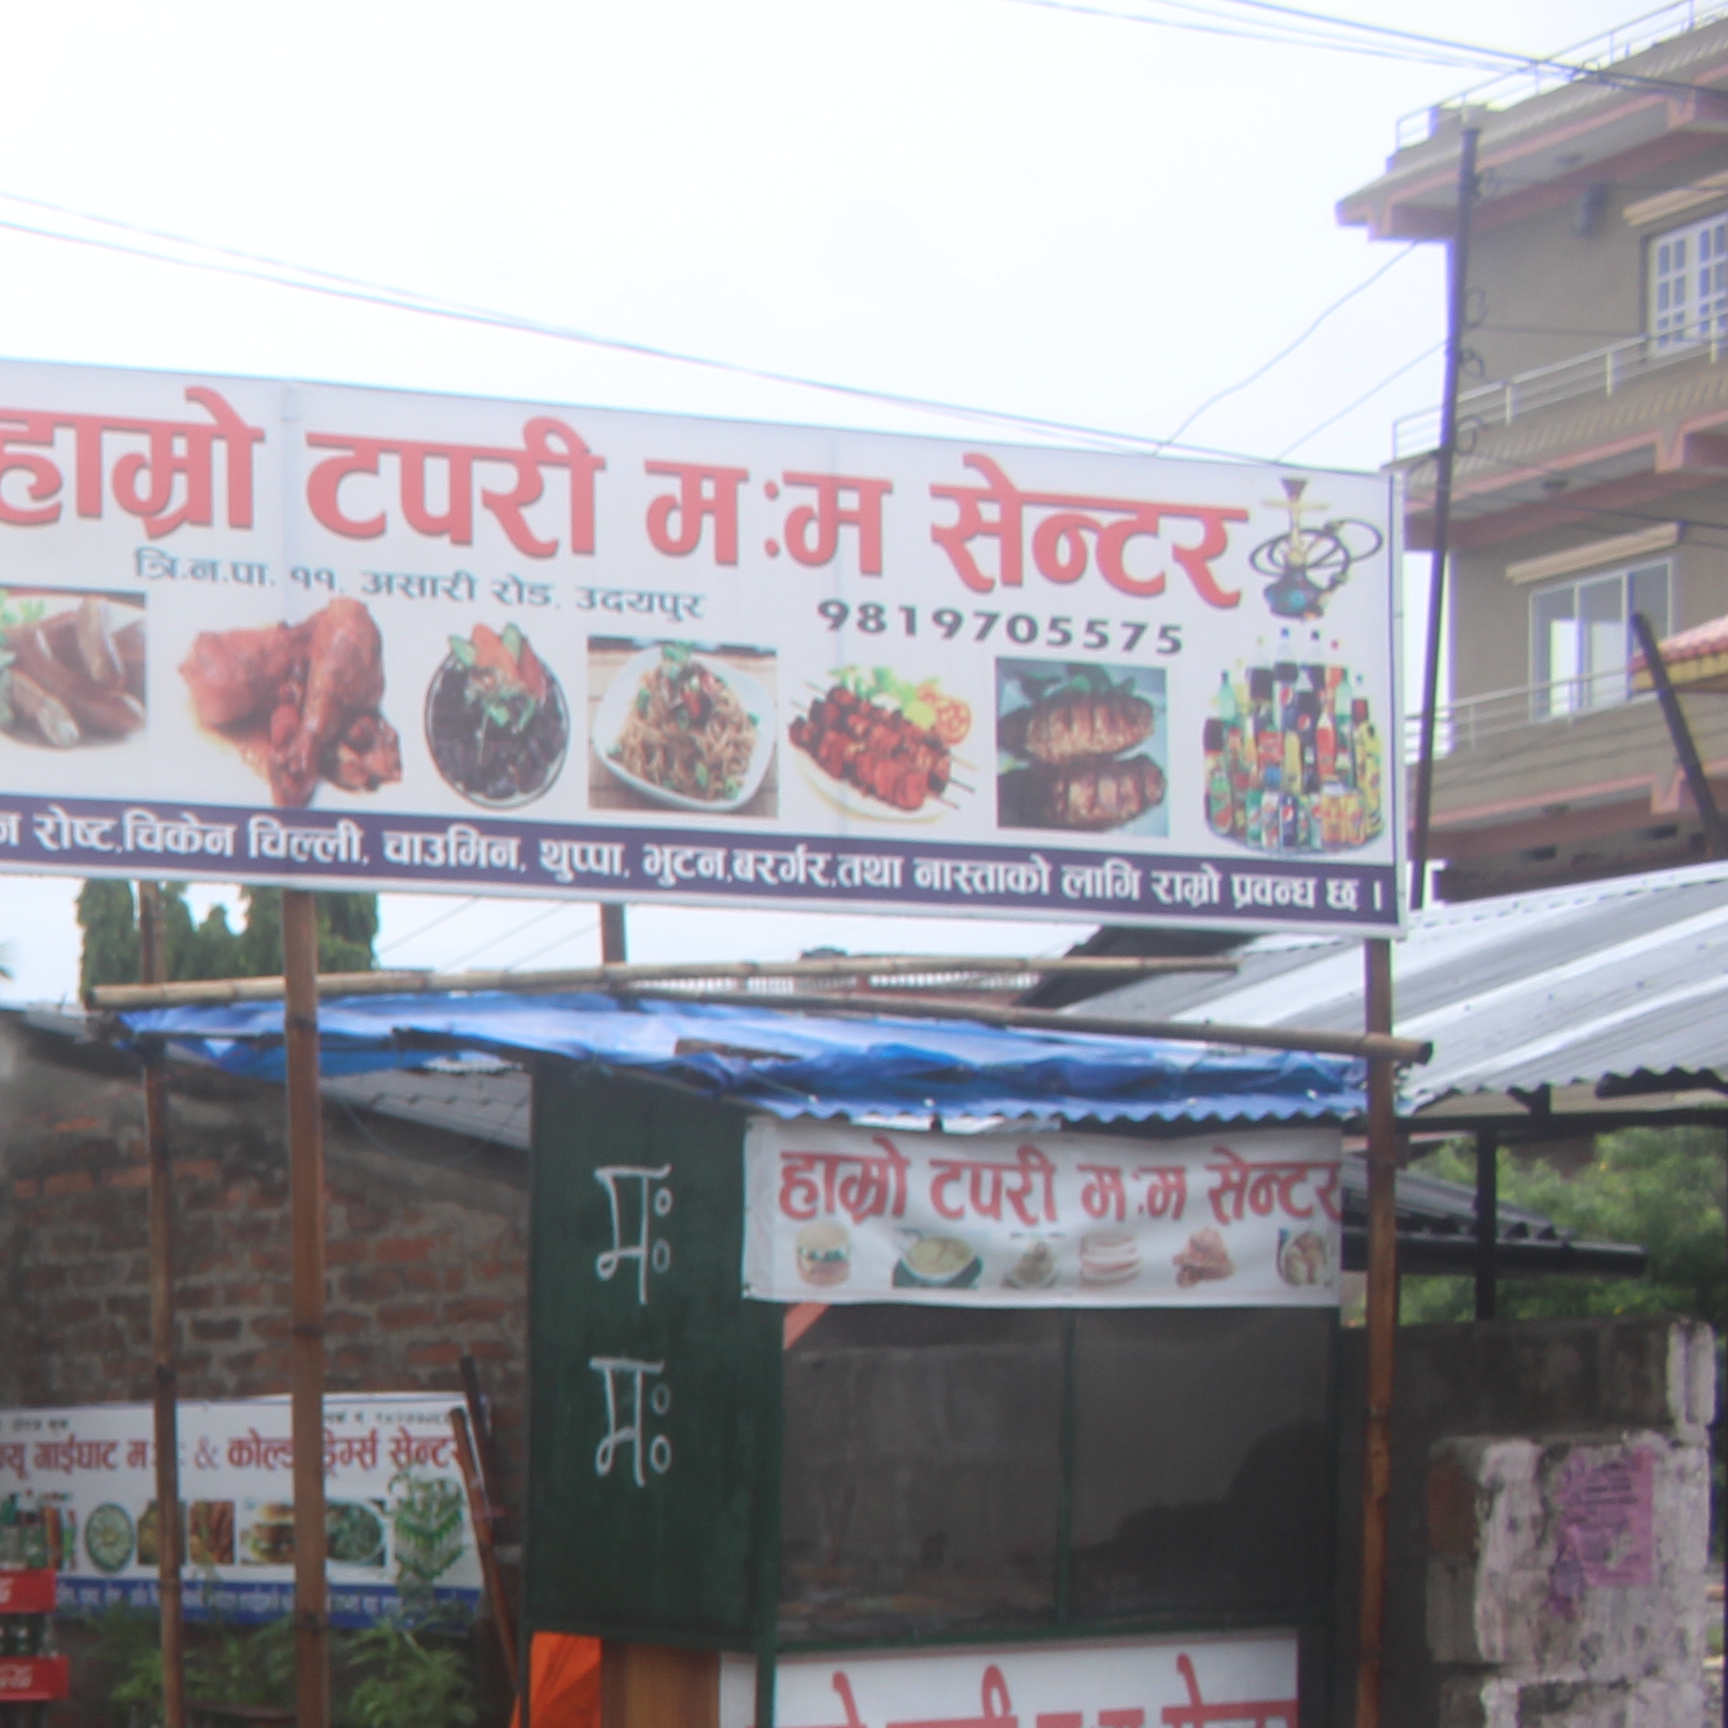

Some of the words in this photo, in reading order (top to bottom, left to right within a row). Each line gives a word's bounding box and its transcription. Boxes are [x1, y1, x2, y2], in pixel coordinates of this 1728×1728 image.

[304, 415, 606, 557] टपरी
[930, 452, 1249, 608] सेन्टर
[360, 570, 477, 602] असारी
[575, 585, 707, 622] उदयपुर
[816, 599, 1184, 655] 9819705575
[913, 853, 1051, 898] नास्ताको
[1060, 858, 1141, 902] लागि
[1150, 864, 1222, 907] राम्रो
[1325, 878, 1359, 912] छ
[778, 1135, 910, 1226] हाम्रो
[929, 1144, 1057, 1227] टपरी
[1205, 1146, 1342, 1226] सेन्टर
